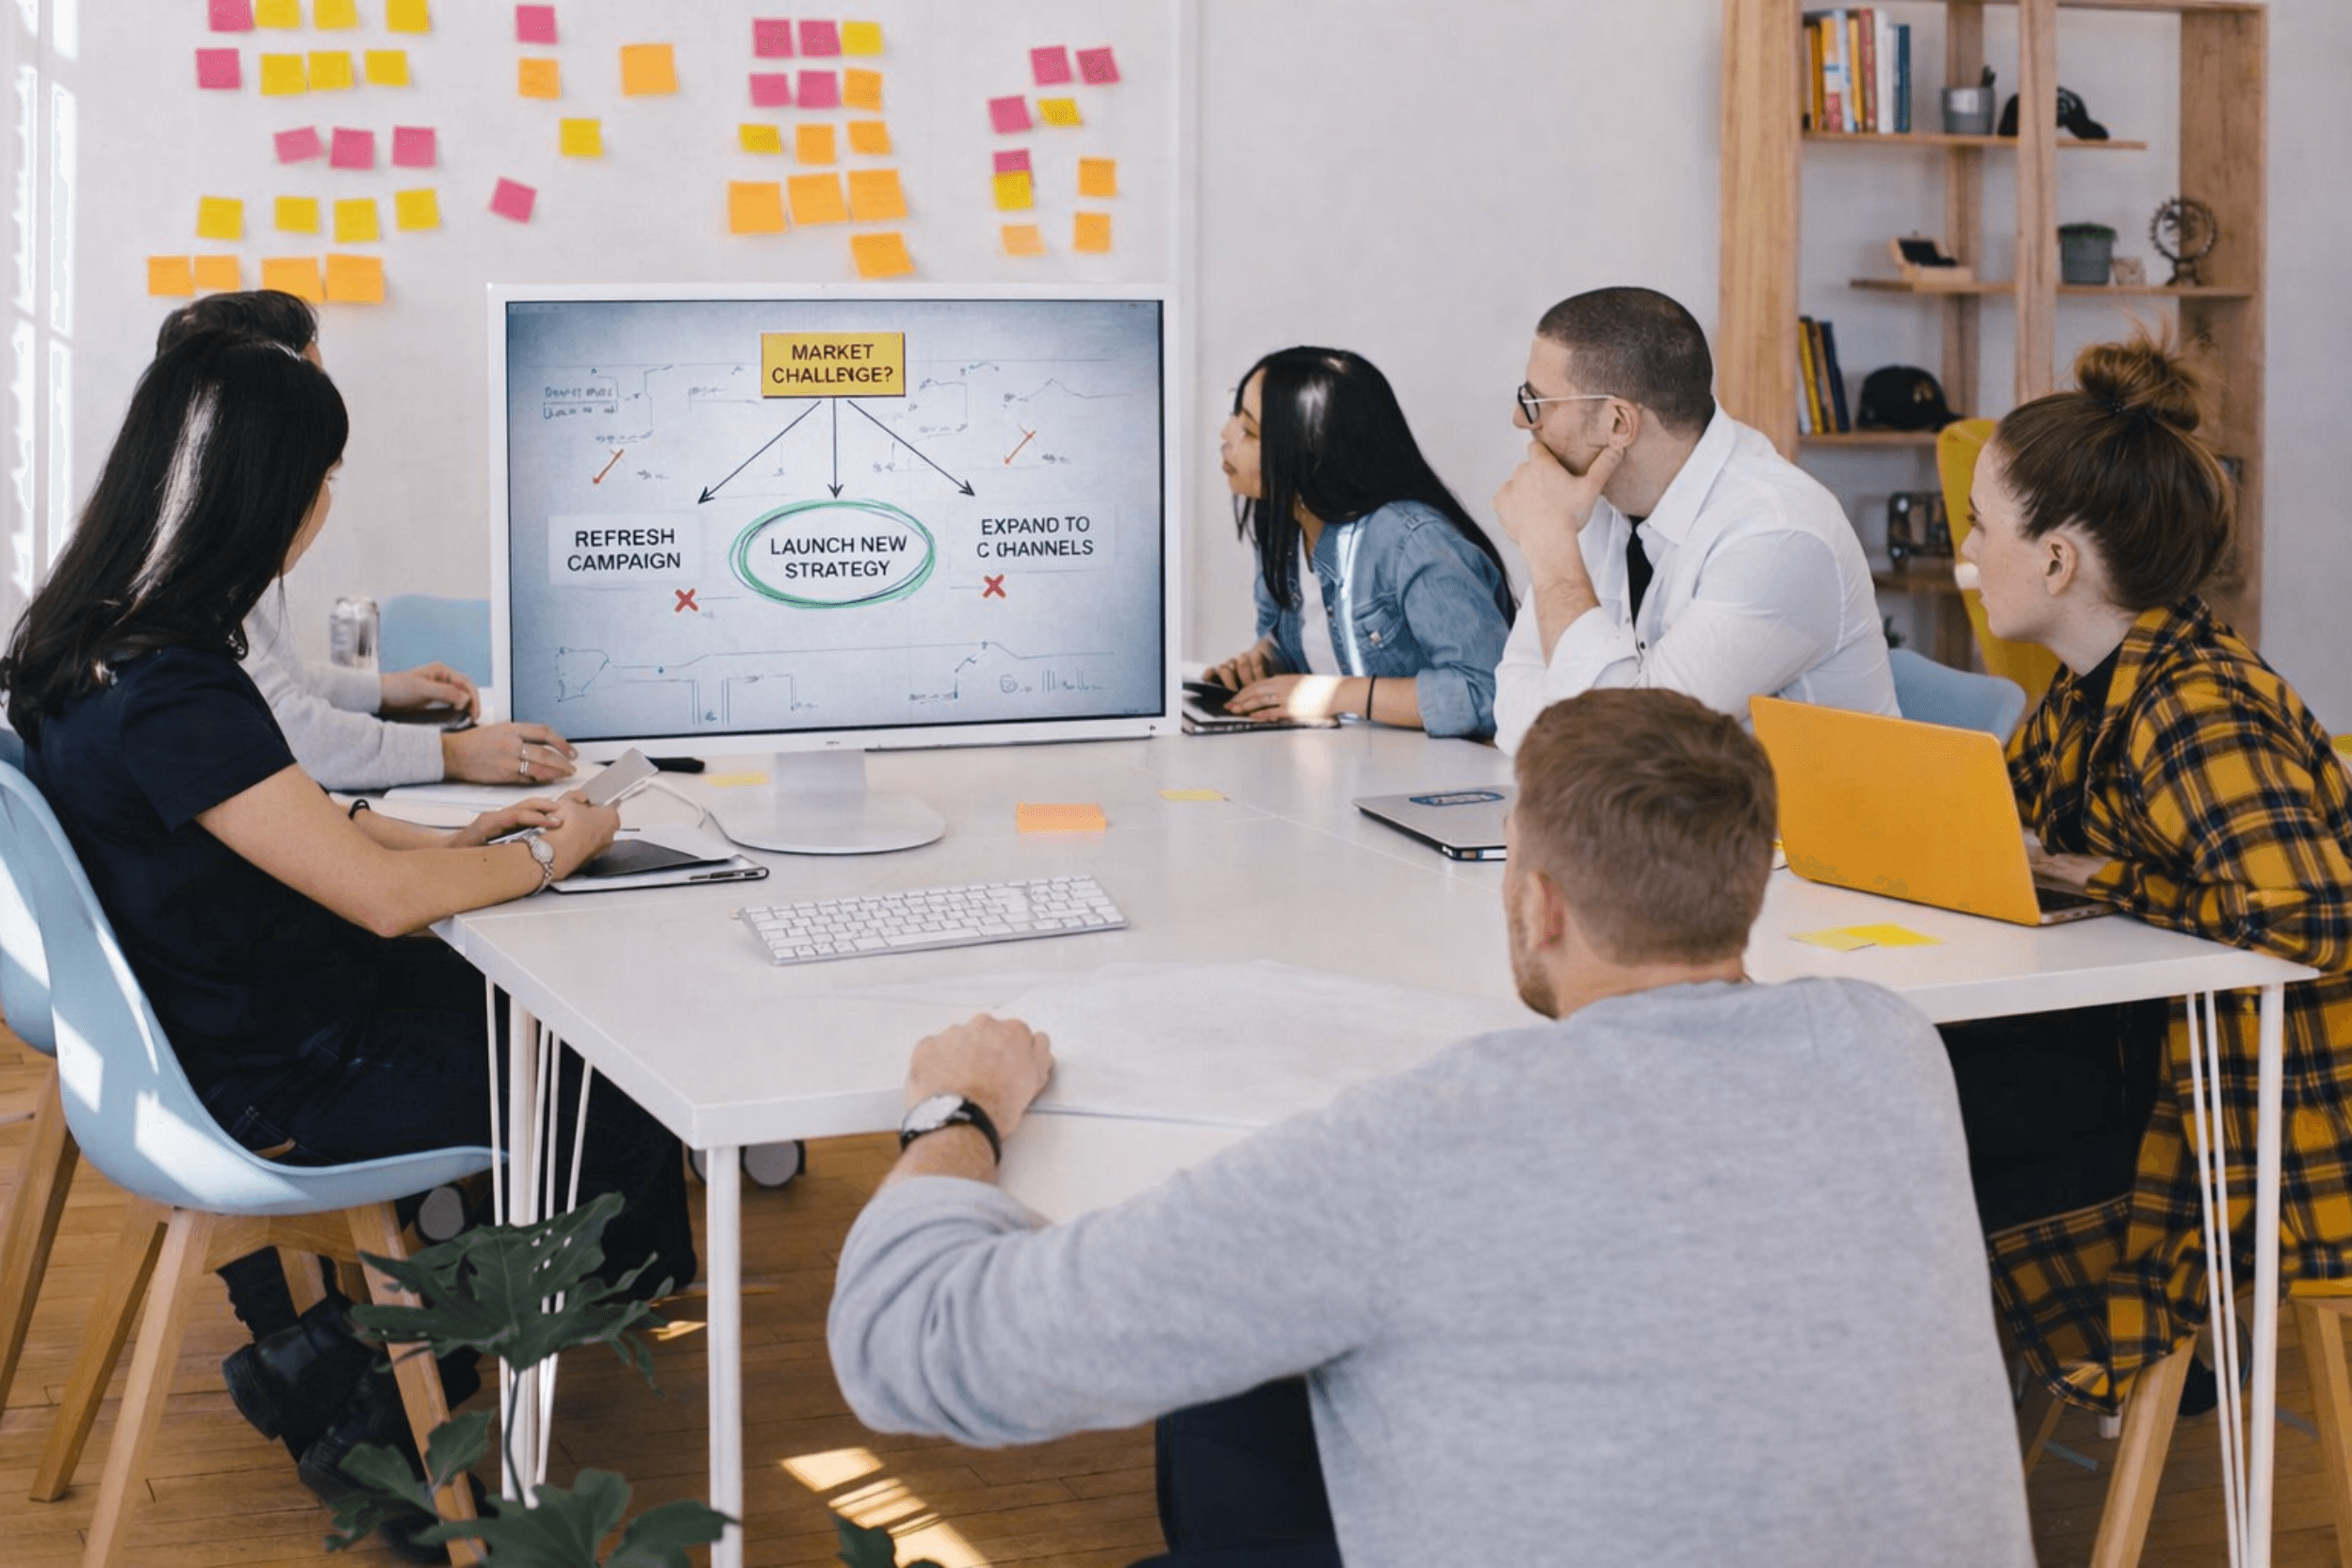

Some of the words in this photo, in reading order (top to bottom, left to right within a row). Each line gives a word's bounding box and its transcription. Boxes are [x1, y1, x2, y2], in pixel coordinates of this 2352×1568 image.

[792, 344, 874, 361] MARKET
[772, 366, 893, 384] CHALLENGE?
[981, 517, 1059, 535] EXPAND
[1065, 515, 1090, 532] TO
[575, 528, 675, 547] REFRESH
[771, 537, 855, 555] LAUNCH
[861, 535, 907, 552] NEW
[567, 552, 680, 572] CAMPAIGN
[785, 560, 890, 580] STRATEGY
